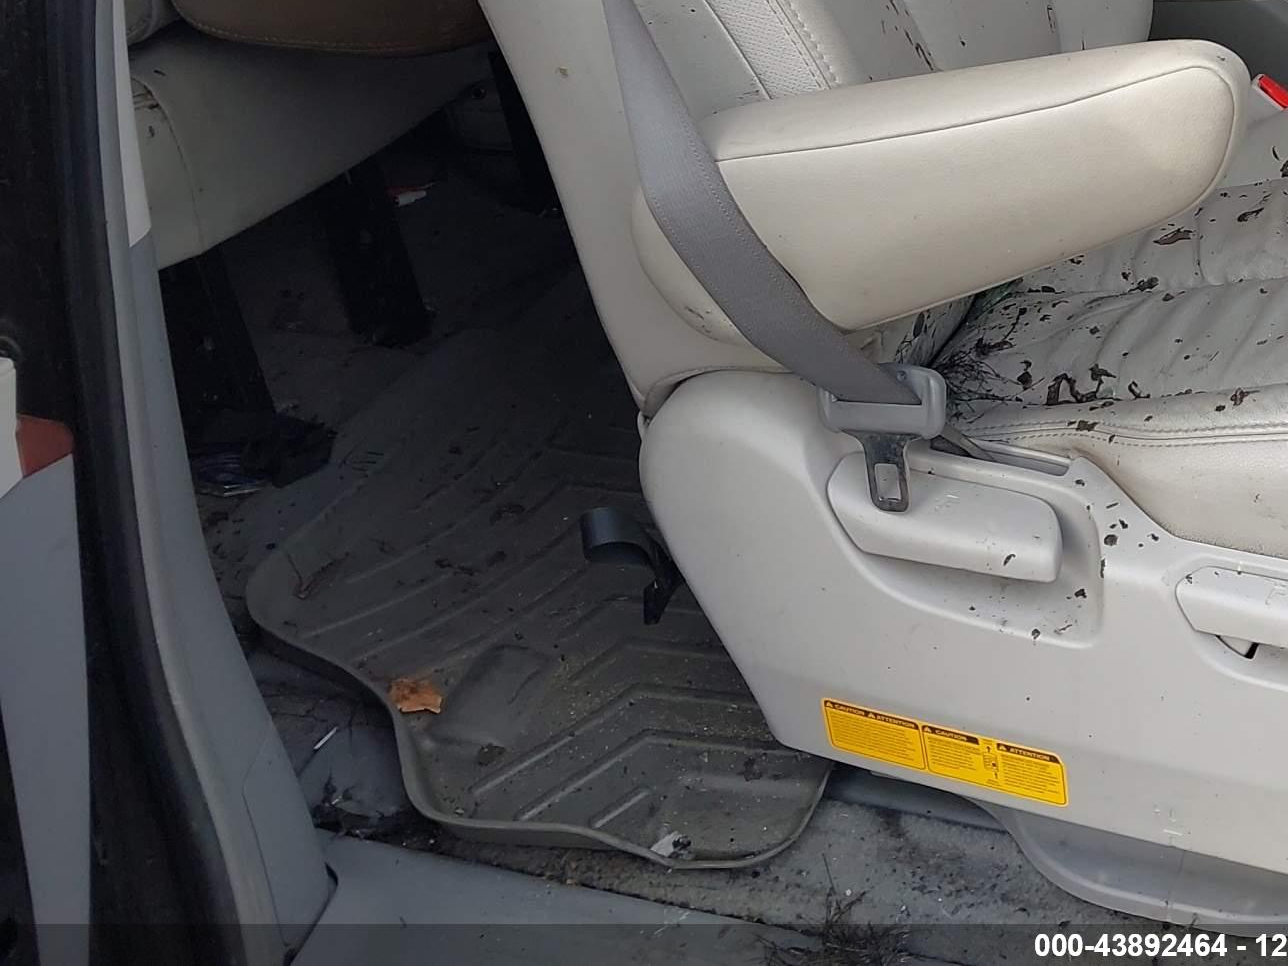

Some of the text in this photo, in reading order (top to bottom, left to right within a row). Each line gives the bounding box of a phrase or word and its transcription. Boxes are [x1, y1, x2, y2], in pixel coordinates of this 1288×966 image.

[834, 704, 915, 729] CAUTION ATTENTION
[935, 729, 968, 741] CAUTION
[1009, 747, 1051, 762] ATTENTION
